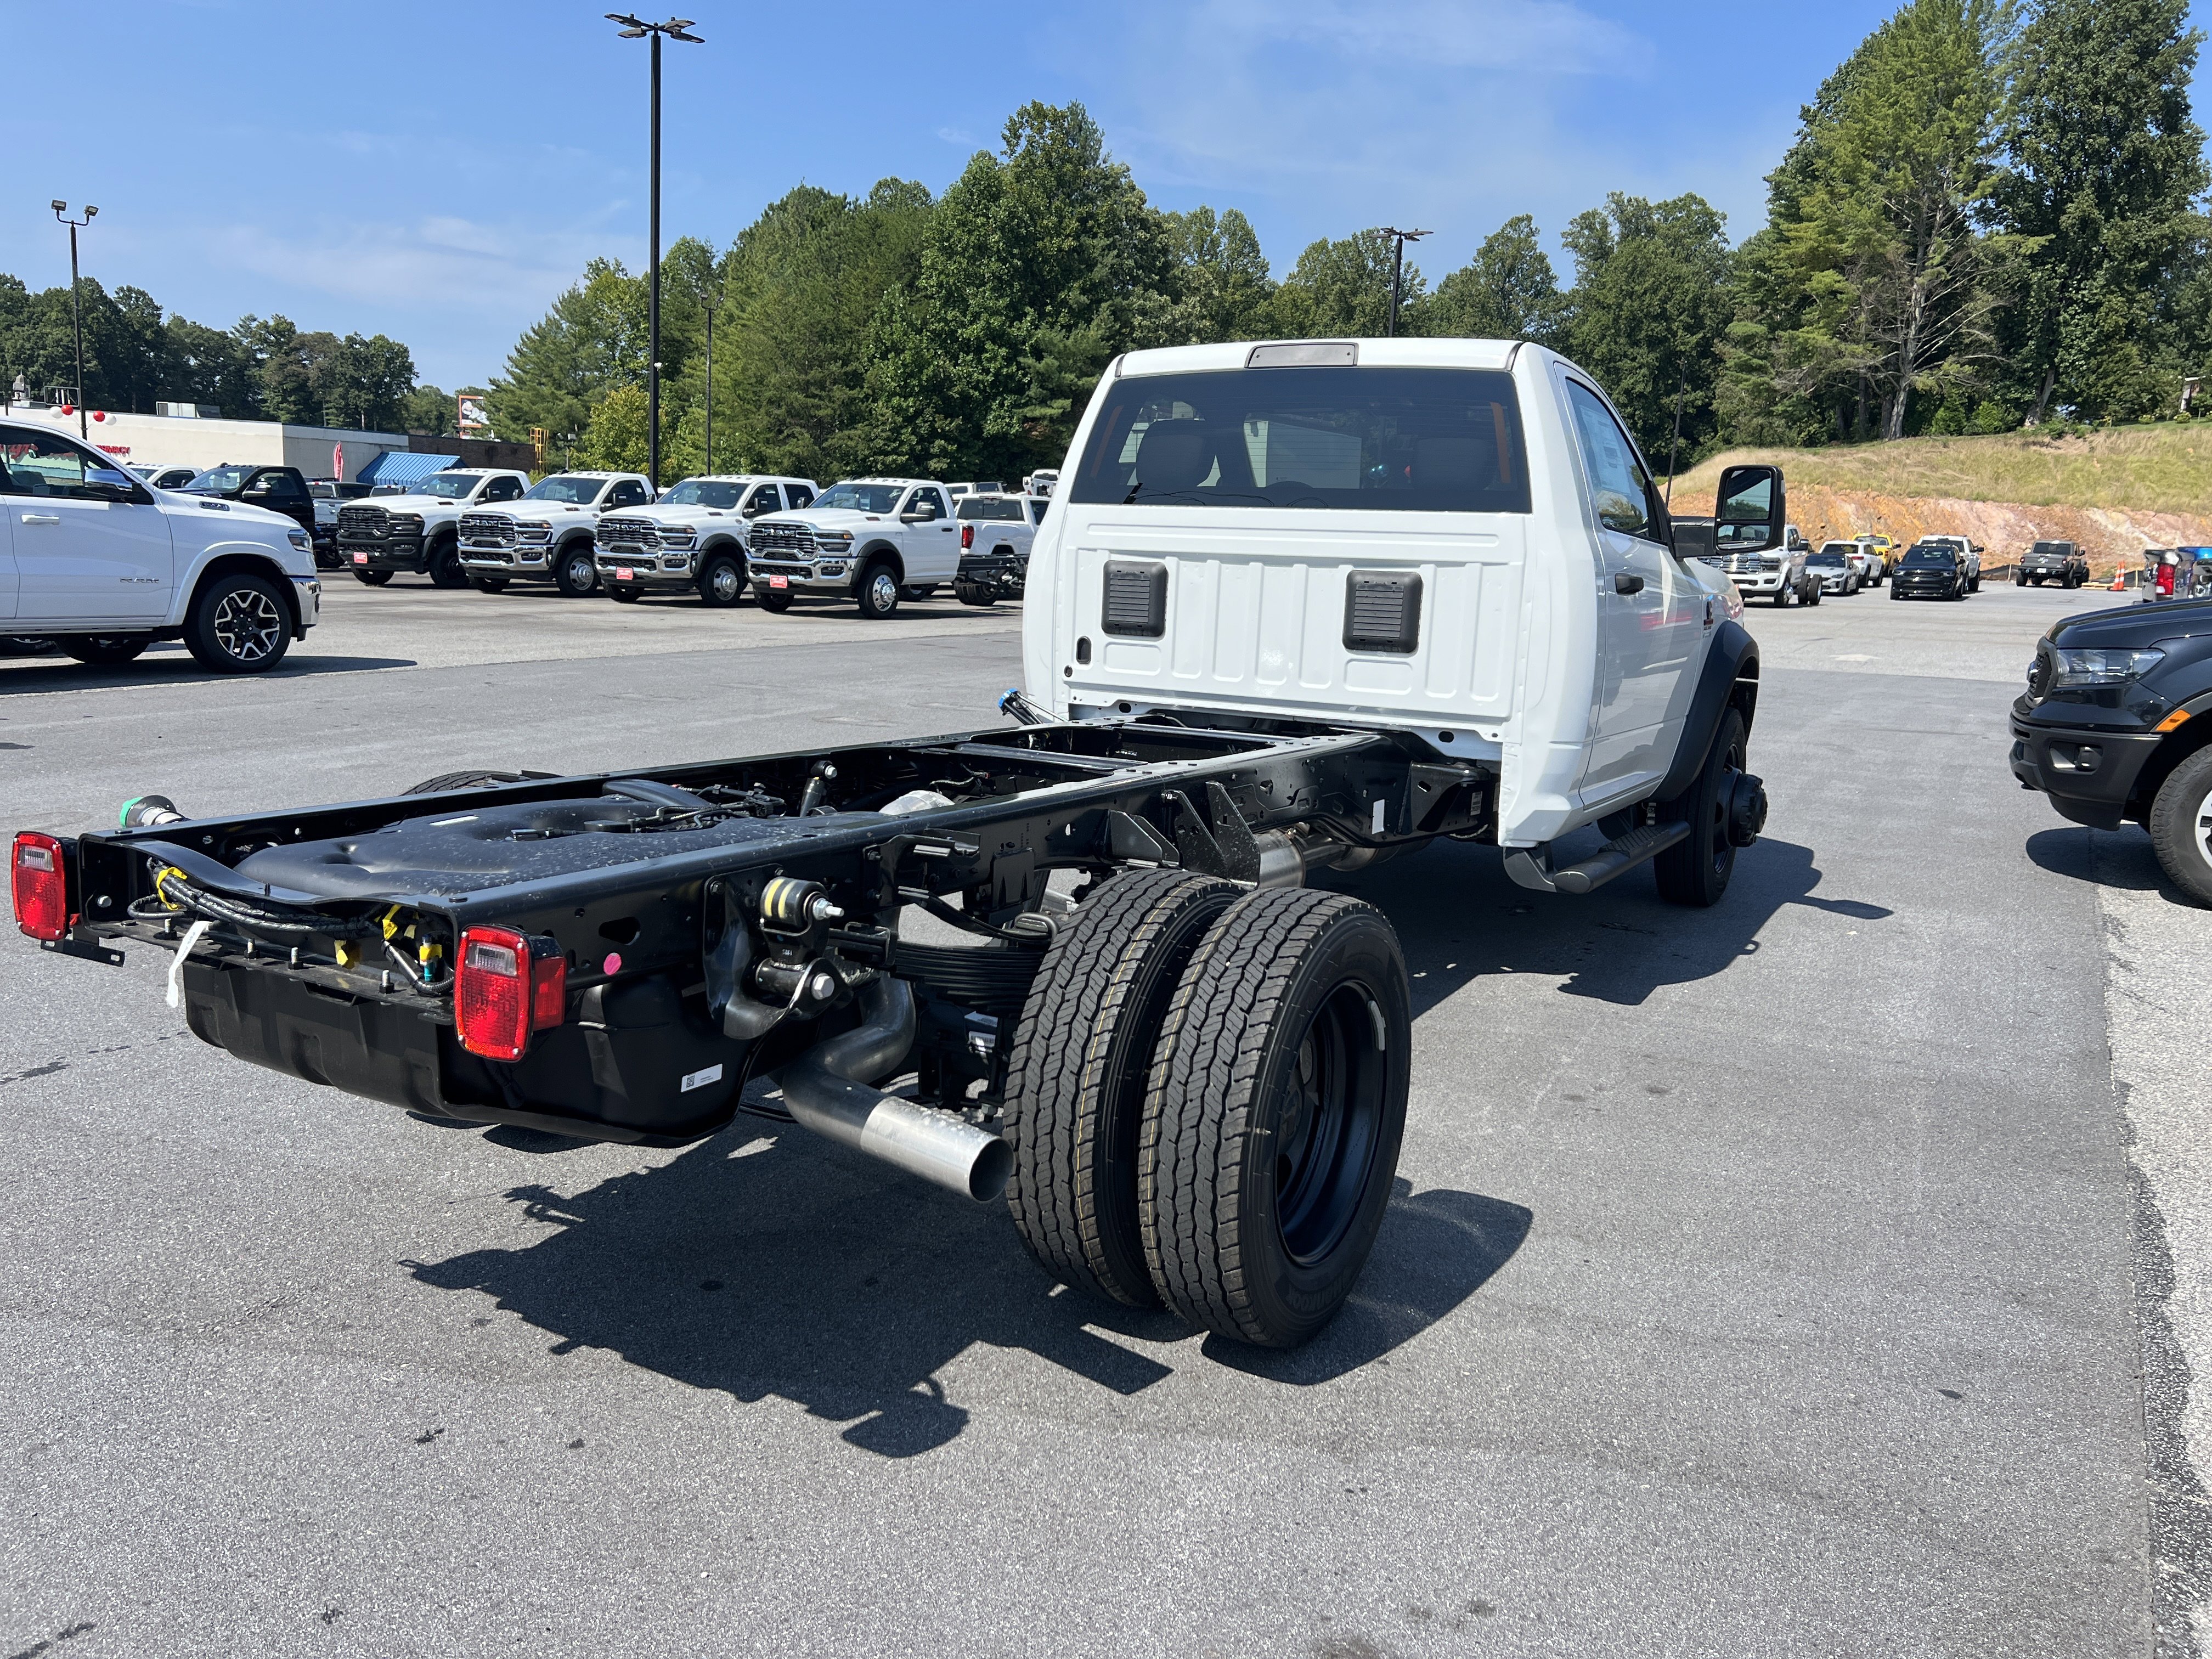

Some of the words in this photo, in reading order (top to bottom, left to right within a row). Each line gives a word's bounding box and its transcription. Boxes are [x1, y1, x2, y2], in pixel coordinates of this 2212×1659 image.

[608, 523, 640, 531] RAM
[762, 528, 795, 537] RAM
[1285, 1276, 1344, 1312] Hankook
